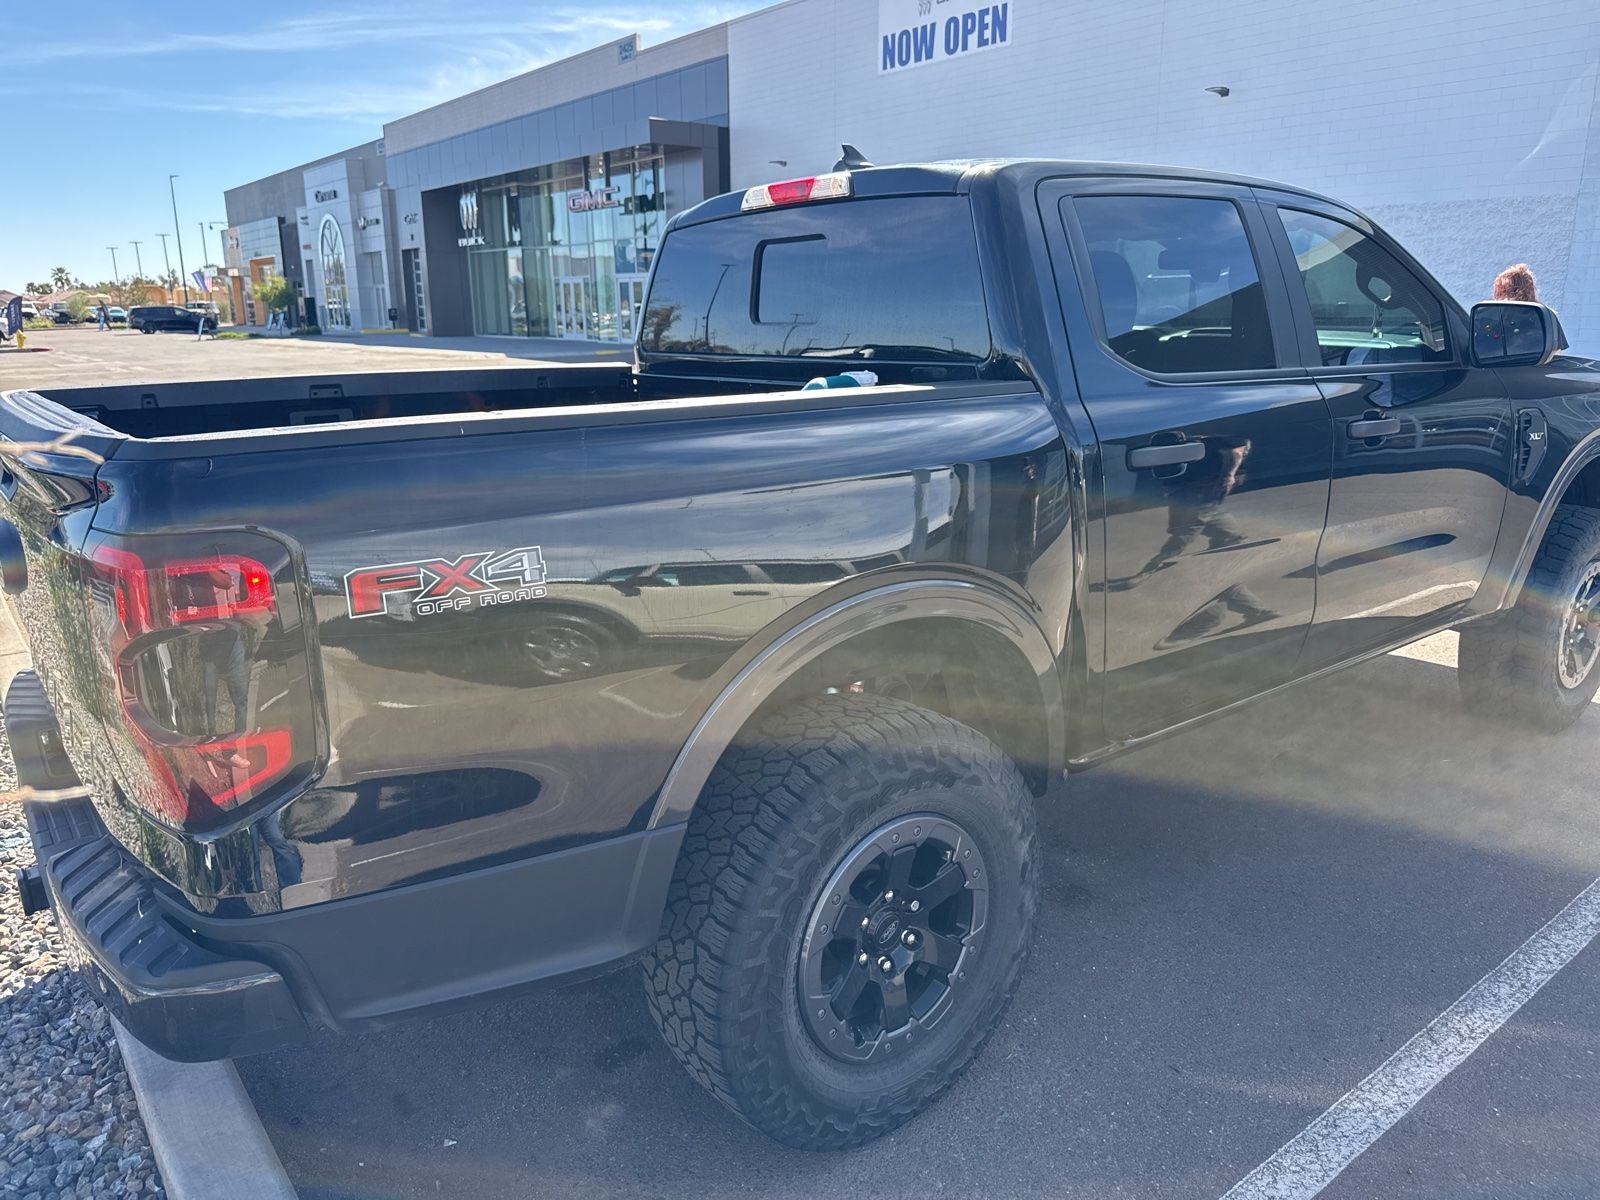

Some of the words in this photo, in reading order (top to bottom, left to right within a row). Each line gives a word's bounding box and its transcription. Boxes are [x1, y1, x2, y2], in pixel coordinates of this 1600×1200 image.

[882, 22, 936, 71] NOW
[944, 3, 1008, 56] OPEN
[569, 186, 619, 212] GMC
[458, 236, 485, 247] BUICK
[344, 545, 547, 619] FX4
[417, 598, 472, 616] OFF
[480, 587, 548, 606] ROAD
